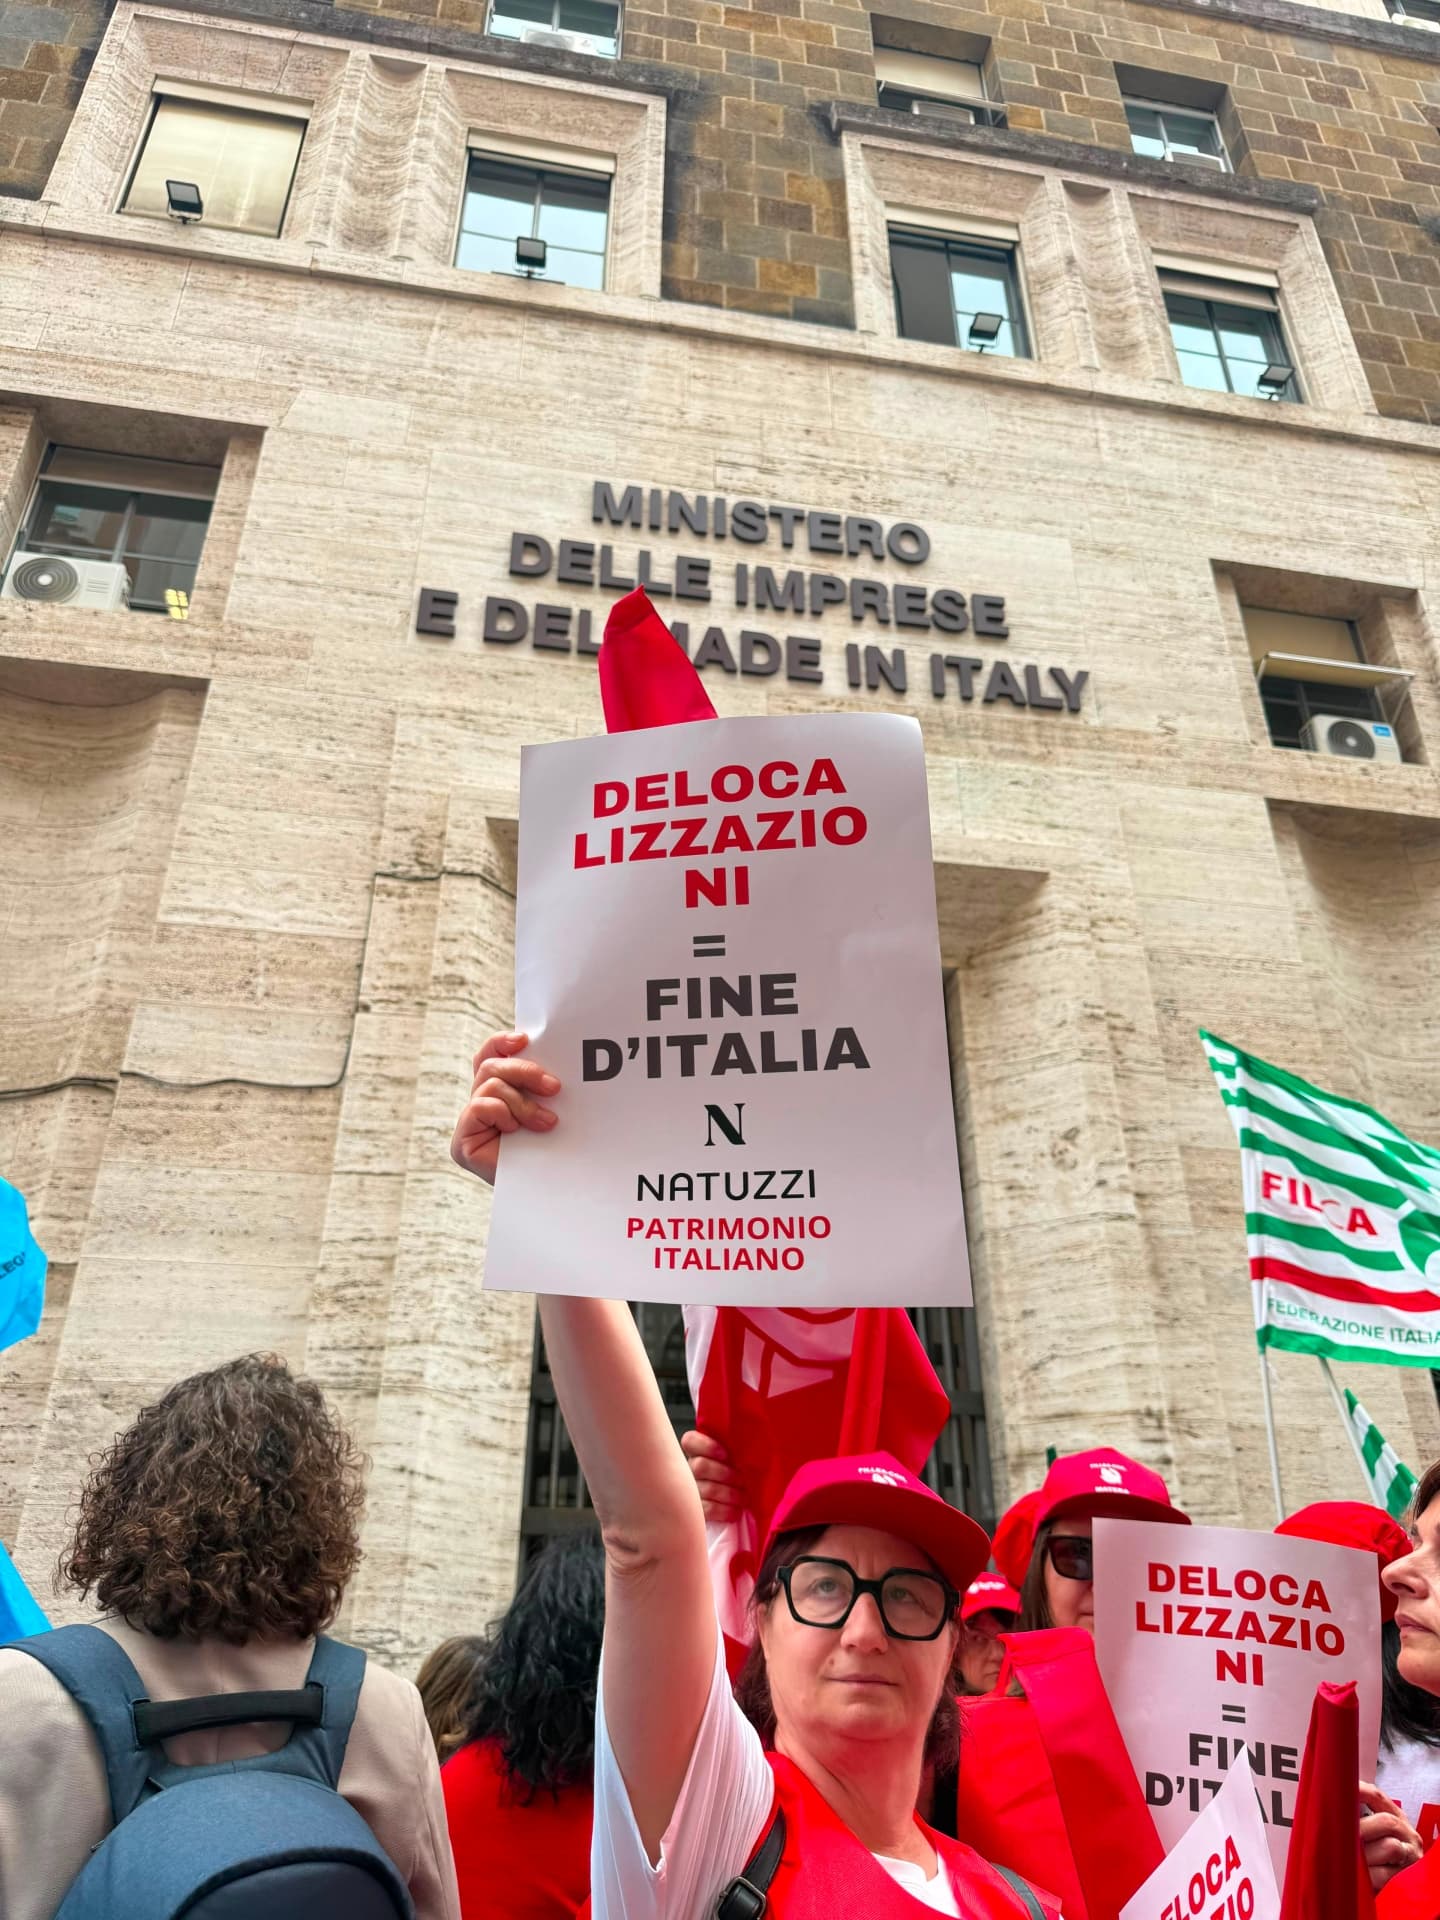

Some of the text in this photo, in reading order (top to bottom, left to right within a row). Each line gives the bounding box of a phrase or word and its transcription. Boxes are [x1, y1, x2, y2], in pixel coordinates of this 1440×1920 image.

[592, 481, 931, 564] MINISTERO
[509, 531, 1009, 639] DELLE IMPRESE
[416, 588, 458, 638] E
[483, 596, 603, 655] DEL
[846, 643, 907, 694] IN
[931, 653, 1090, 713] ITALY
[593, 758, 846, 819] DELOCA
[574, 806, 867, 870] LIZZAZIO
[685, 866, 749, 909] NI
[647, 973, 798, 1021] FINE
[583, 1027, 870, 1082] D'ITALIA
[704, 1103, 746, 1146] N
[637, 1169, 816, 1202] NATUZZI
[627, 1216, 831, 1240] PATRIMONIO
[654, 1247, 804, 1271] ITALIANO
[1267, 1297, 1384, 1339] FEDERAZIONE
[1149, 1562, 1332, 1614] DELOCA
[1135, 1601, 1345, 1657] LIZZAZIO
[1215, 1649, 1264, 1687] NI
[1189, 1733, 1299, 1782] FINE
